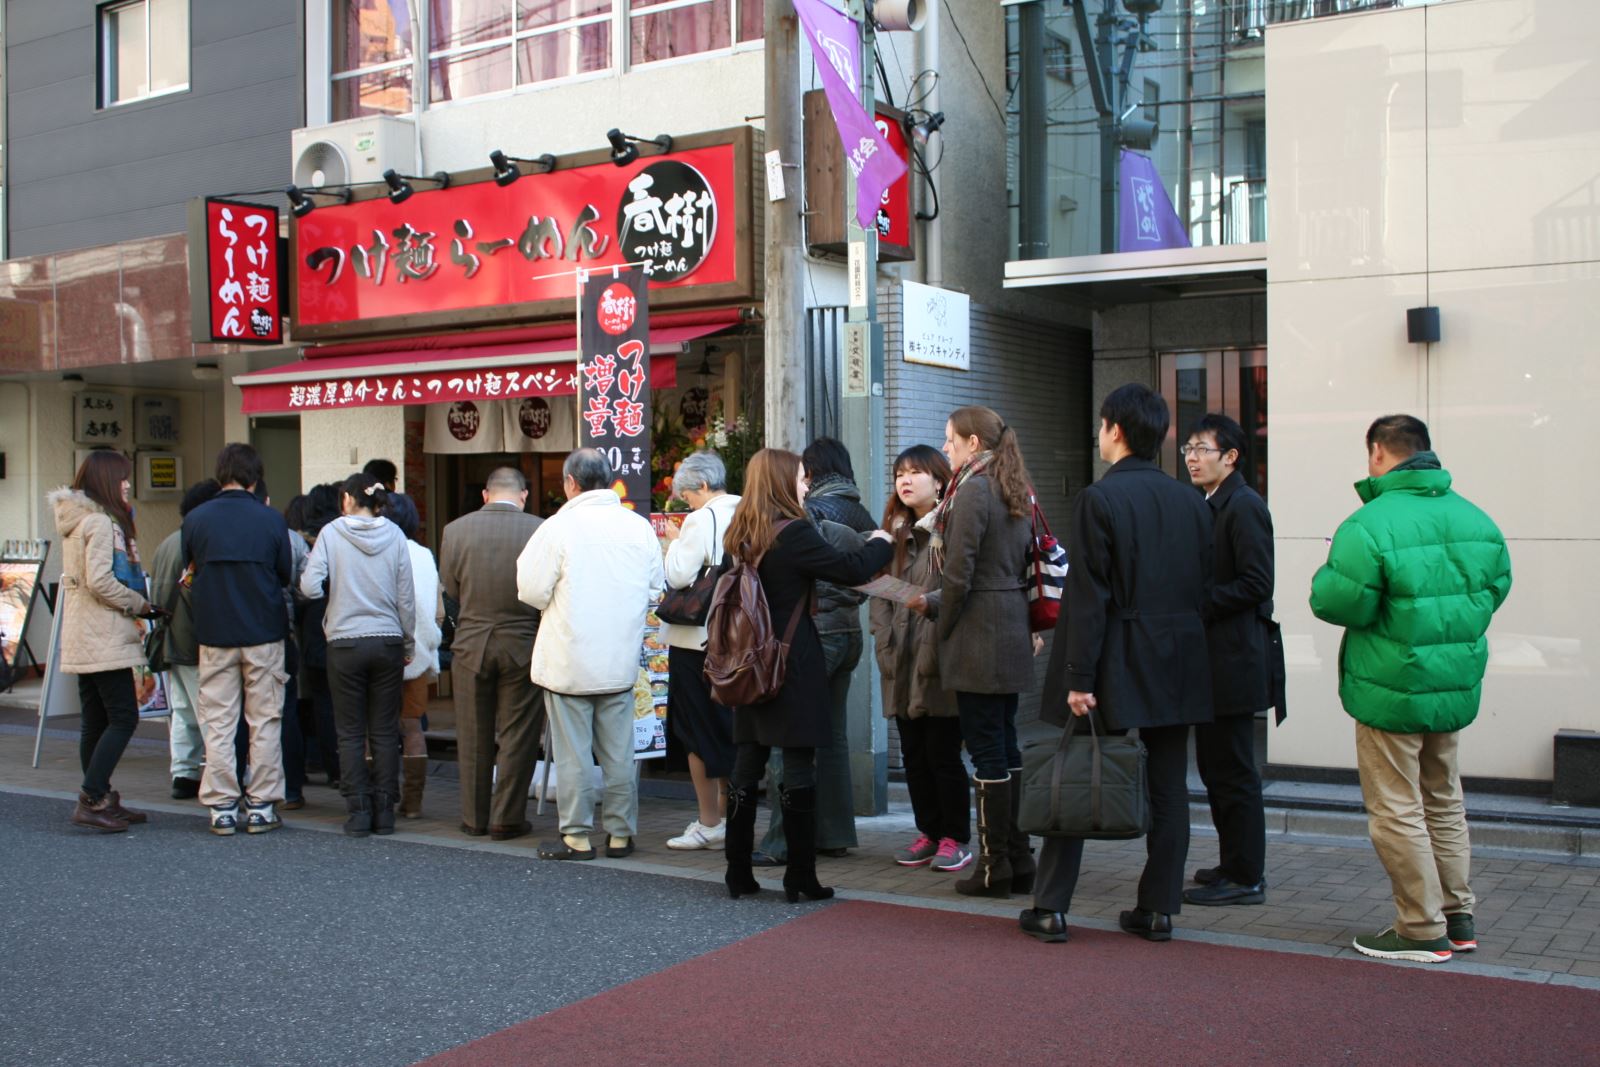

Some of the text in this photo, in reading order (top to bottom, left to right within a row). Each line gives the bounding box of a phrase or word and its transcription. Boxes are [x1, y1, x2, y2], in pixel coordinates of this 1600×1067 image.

[244, 214, 272, 303] つけ麺
[621, 172, 714, 258] 春樹
[634, 240, 673, 257] つけ麺
[219, 207, 246, 336] らーめん
[583, 354, 617, 438] 増量
[617, 340, 646, 438] つけ麺
